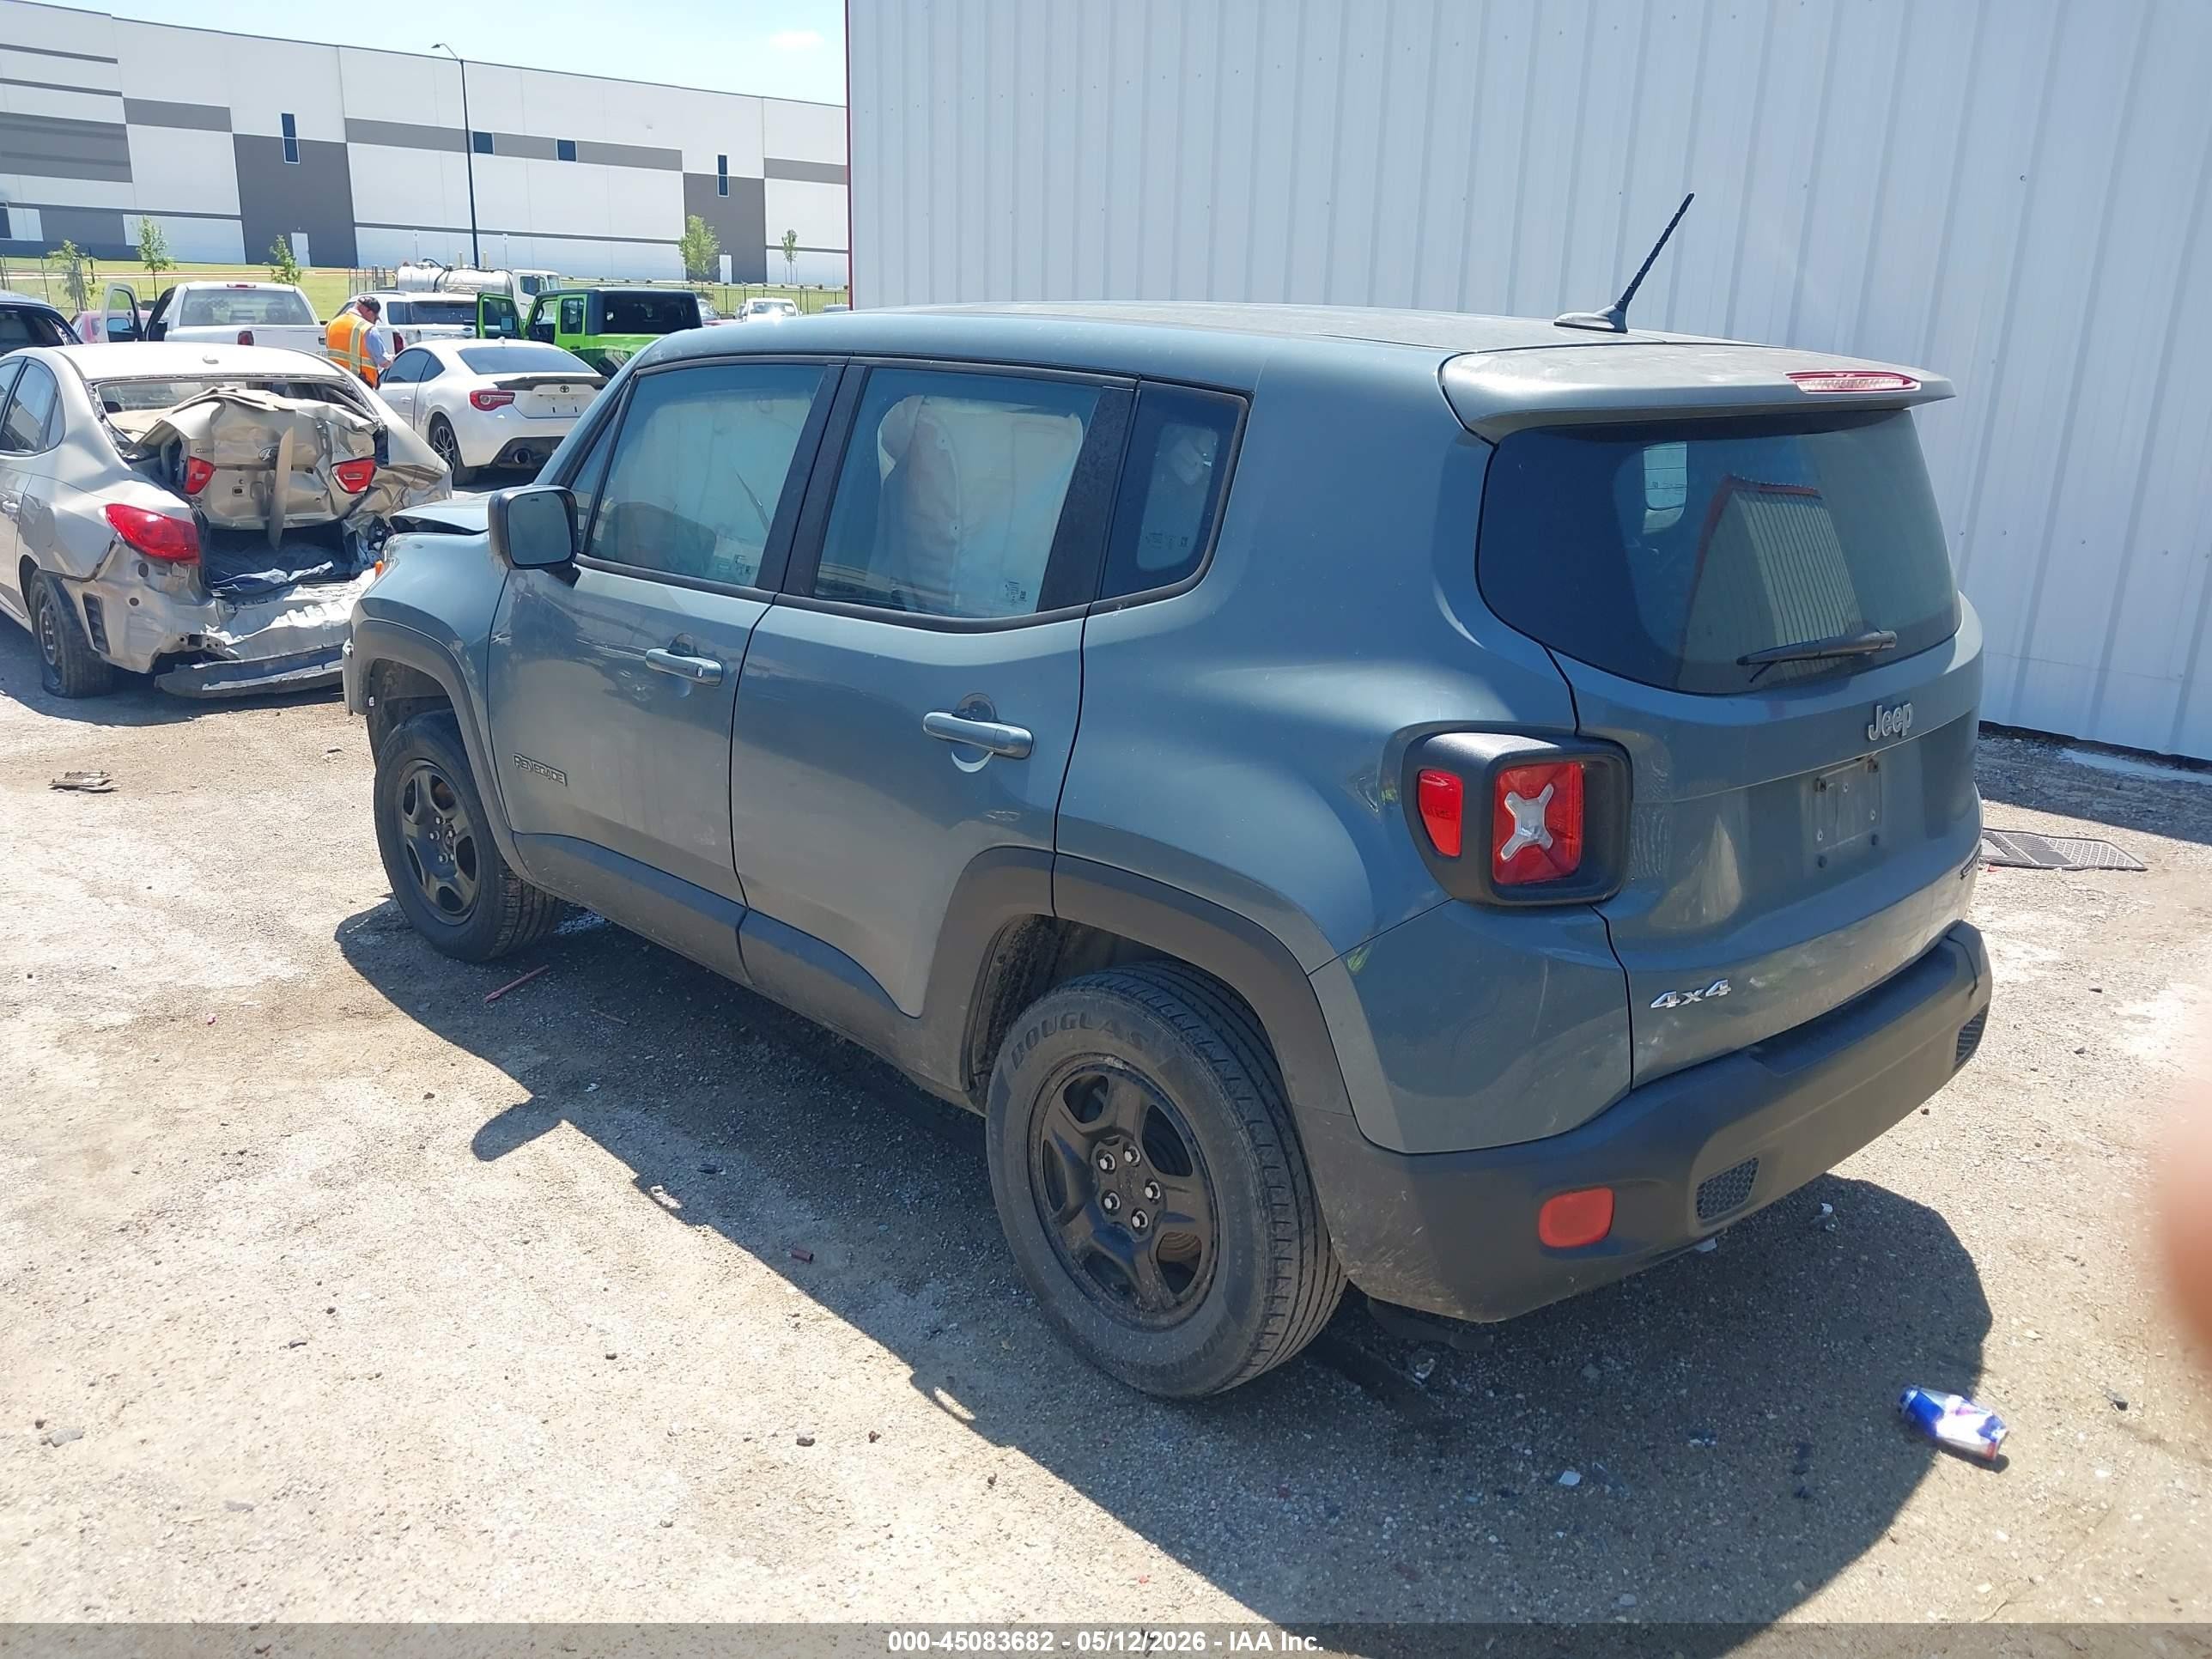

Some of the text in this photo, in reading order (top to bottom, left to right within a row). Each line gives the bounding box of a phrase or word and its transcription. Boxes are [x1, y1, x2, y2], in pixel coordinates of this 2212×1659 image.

[1868, 702, 1914, 741] Jeep
[512, 753, 568, 786] RENEGADE
[1650, 979, 1732, 1009] 4x4
[1010, 1011, 1149, 1071] DOUGLAS
